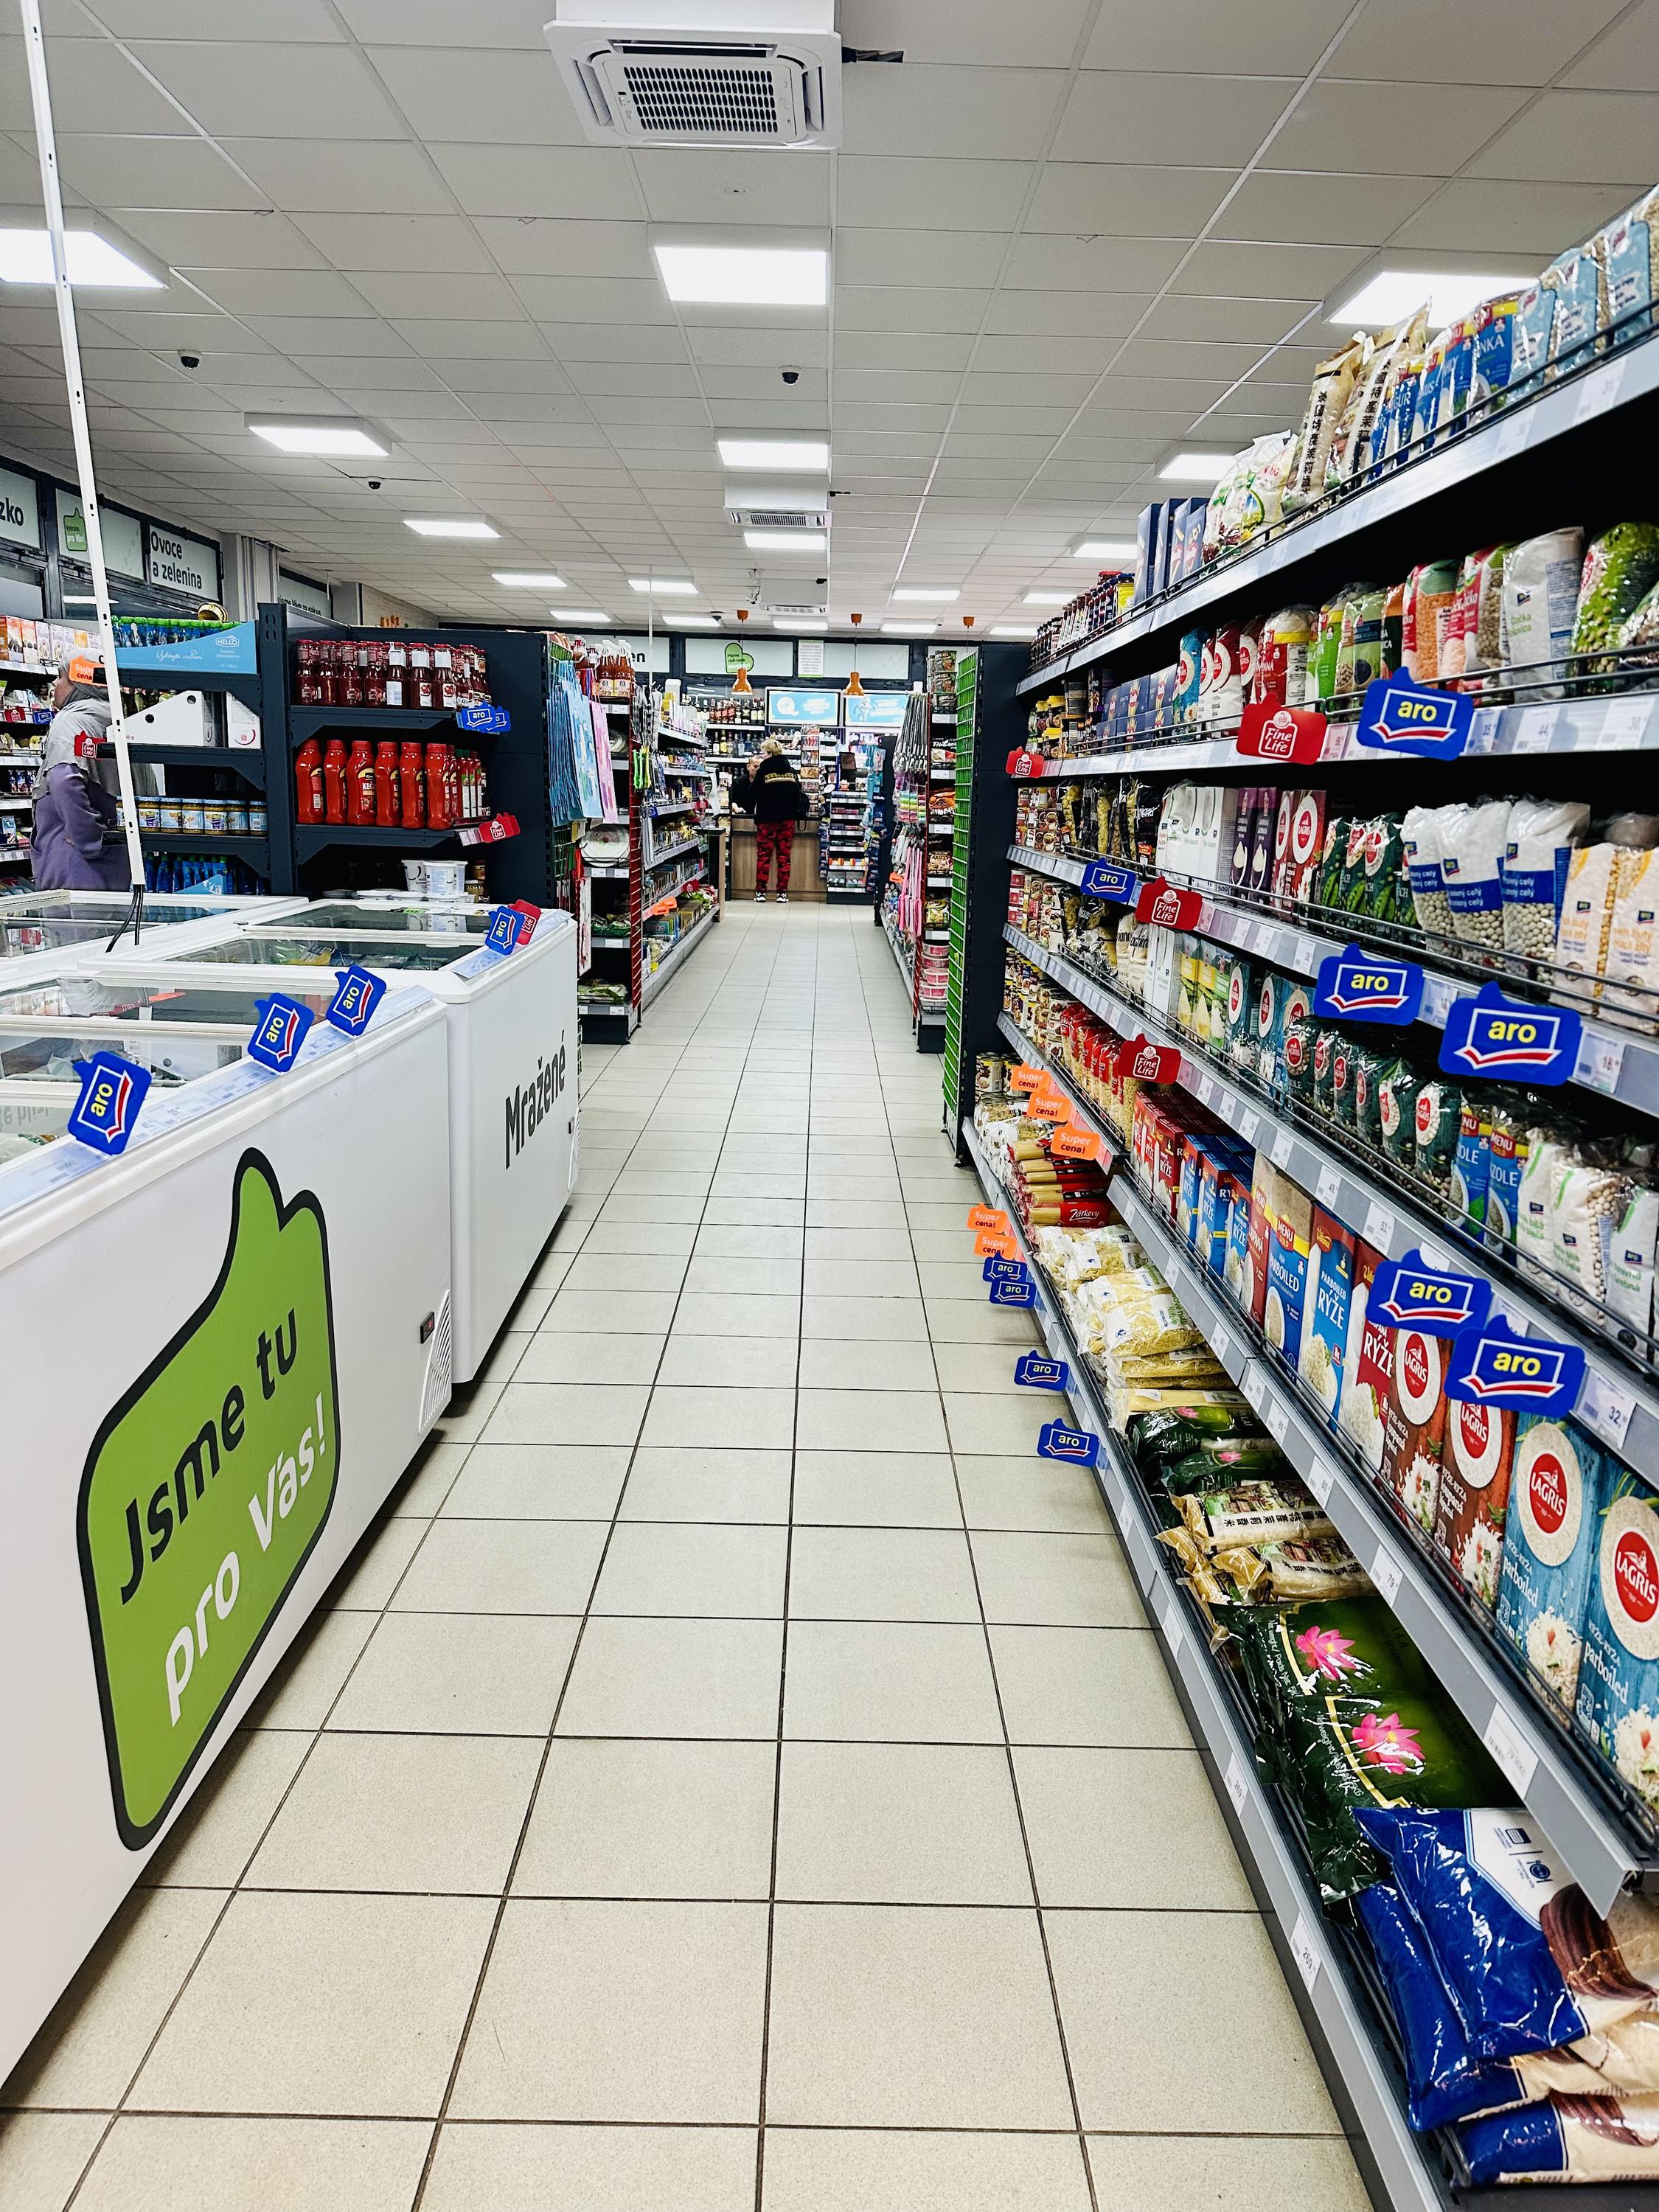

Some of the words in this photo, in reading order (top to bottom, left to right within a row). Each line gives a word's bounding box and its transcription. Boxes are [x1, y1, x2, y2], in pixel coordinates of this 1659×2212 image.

[150, 531, 182, 559] Ovoce
[153, 562, 159, 577] a
[161, 563, 202, 590] zelenina
[218, 637, 237, 646] HELLO
[472, 711, 485, 719] aro
[1397, 700, 1437, 722] aro
[1266, 727, 1293, 742] Fine
[1265, 739, 1288, 753] Life
[1099, 873, 1119, 884] aro
[1155, 911, 1174, 921] Life
[1156, 902, 1177, 913] Fine
[495, 921, 507, 937] aro
[1350, 973, 1389, 992] aro
[342, 987, 360, 1009] aro
[266, 1017, 285, 1043] aro
[1488, 1020, 1537, 1043] aro
[1136, 1065, 1154, 1076] Life
[1138, 1057, 1157, 1068] Fine
[1018, 1071, 1044, 1082] Super
[1018, 1079, 1038, 1089] cena!
[91, 1083, 113, 1117] aro
[506, 1029, 566, 1170] Mražené
[1035, 1097, 1063, 1111] Super
[1035, 1107, 1058, 1117] cena!
[1059, 1132, 1092, 1148] Super
[1060, 1143, 1086, 1155] cena!
[1491, 1132, 1513, 1151] MENU
[975, 1211, 1001, 1223] Super
[975, 1220, 996, 1229] cena!
[1069, 1208, 1100, 1222] Zátkovy
[1232, 1224, 1246, 1248] RÝŽE
[1278, 1220, 1293, 1242] MENU
[981, 1236, 1009, 1250] Super
[998, 1263, 1014, 1273] aro
[1005, 1284, 1022, 1294] aro
[1321, 1270, 1346, 1301] PARBOILED
[1409, 1281, 1453, 1304] aro
[1318, 1289, 1345, 1330] RÝŽE
[1363, 1330, 1394, 1379] RÝŽE
[1492, 1351, 1542, 1377] aro
[1032, 1363, 1052, 1375] aro
[1404, 1349, 1427, 1384] LAGRIS
[1461, 1407, 1489, 1443] LAGRIS
[1057, 1433, 1080, 1447] aro
[121, 1385, 246, 1605] Jsme
[256, 1308, 298, 1401] tu
[1531, 1471, 1565, 1517] LAGRIS
[164, 1551, 240, 1727] pro
[248, 1394, 326, 1552] Vás!
[1502, 1554, 1539, 1608] parboiled
[1616, 1551, 1657, 1604] LAGRIS
[1583, 1638, 1630, 1705] parboiled
[1303, 1947, 1313, 1970] 269
